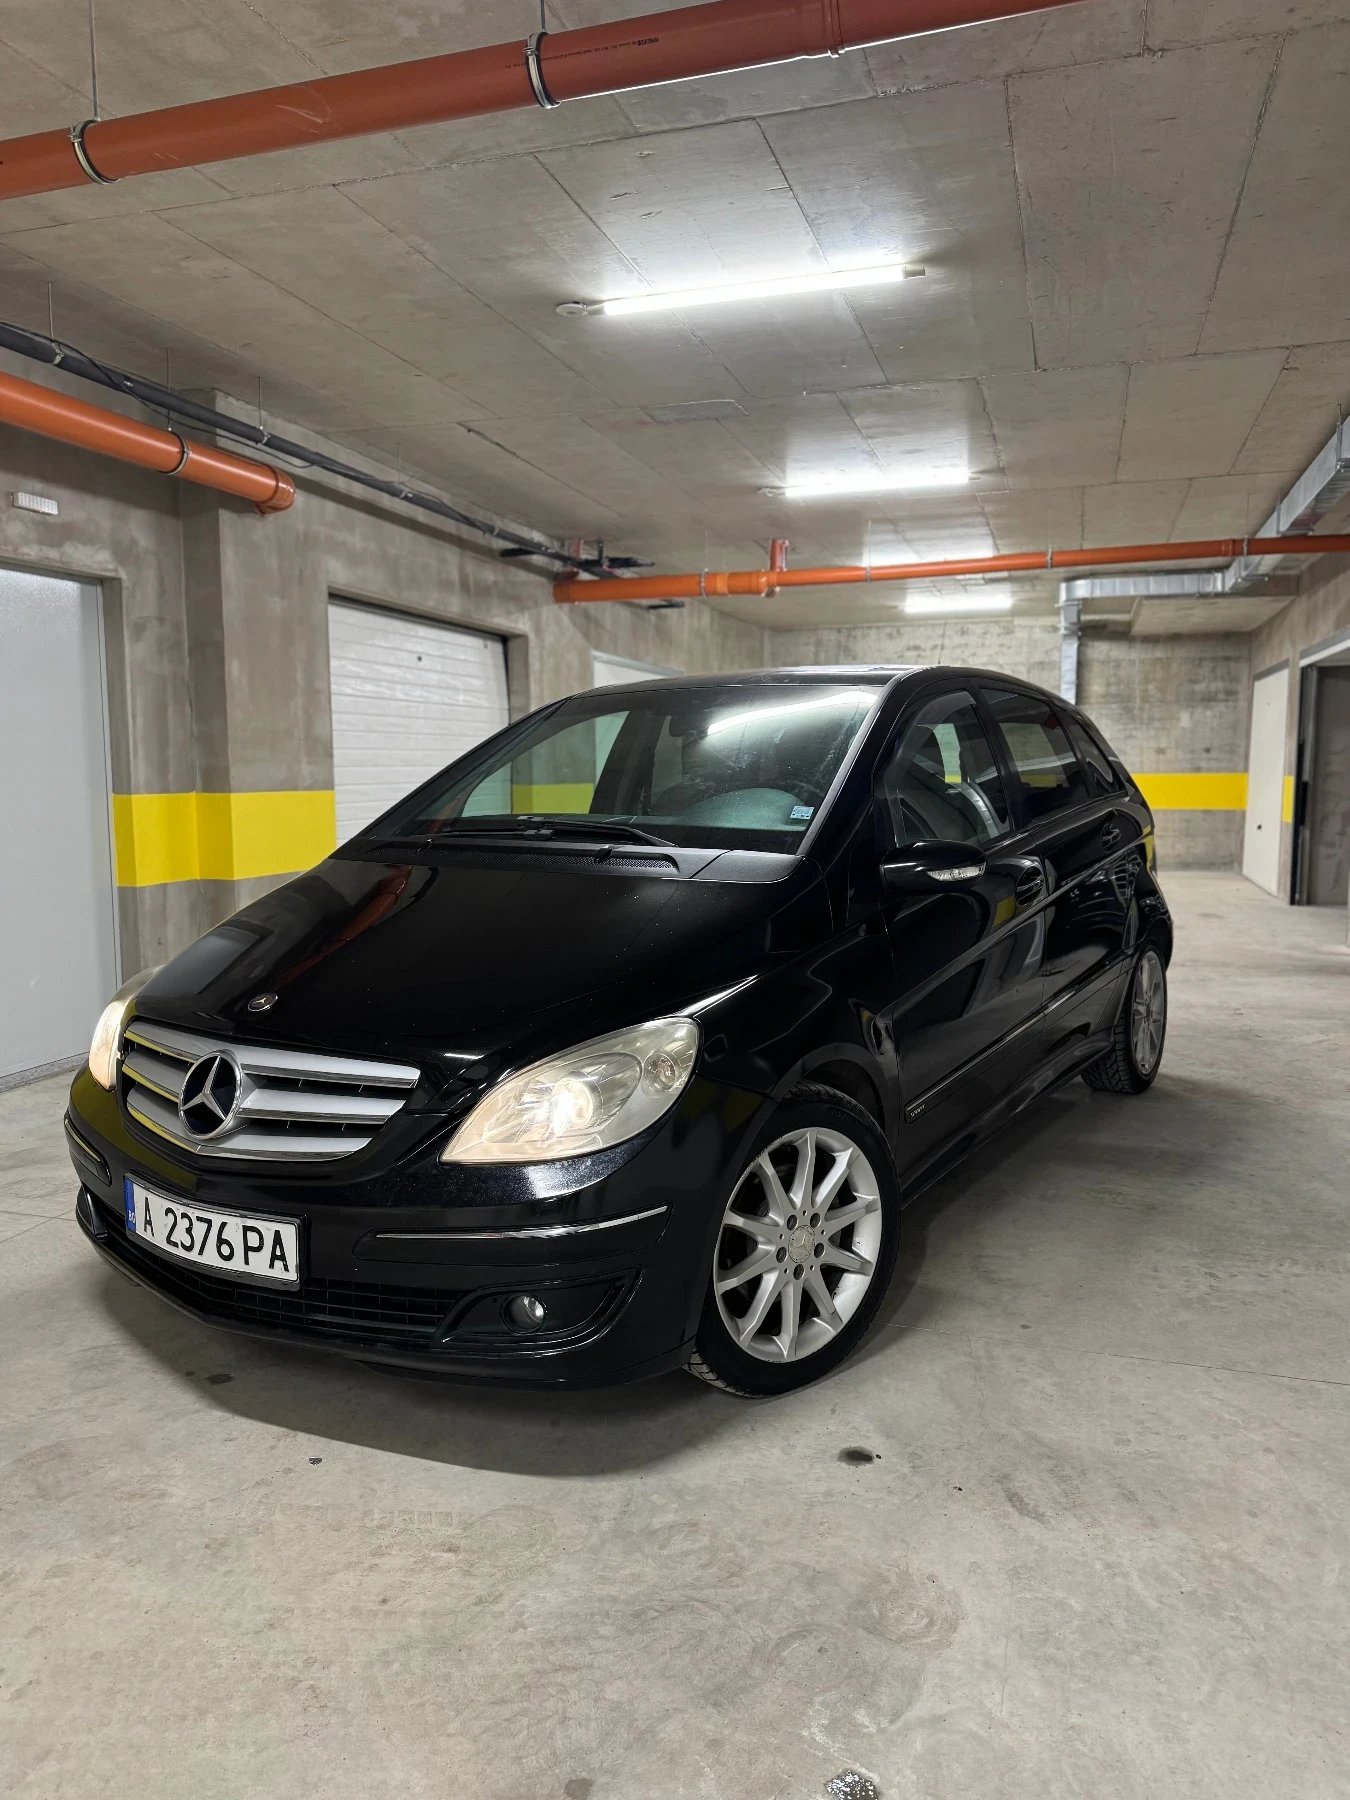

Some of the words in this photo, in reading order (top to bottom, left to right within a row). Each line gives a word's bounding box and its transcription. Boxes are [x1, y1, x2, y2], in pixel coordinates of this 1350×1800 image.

[128, 1210, 136, 1224] BG
[143, 1196, 155, 1238] A
[164, 1206, 235, 1262] 2376
[242, 1224, 290, 1273] PA
